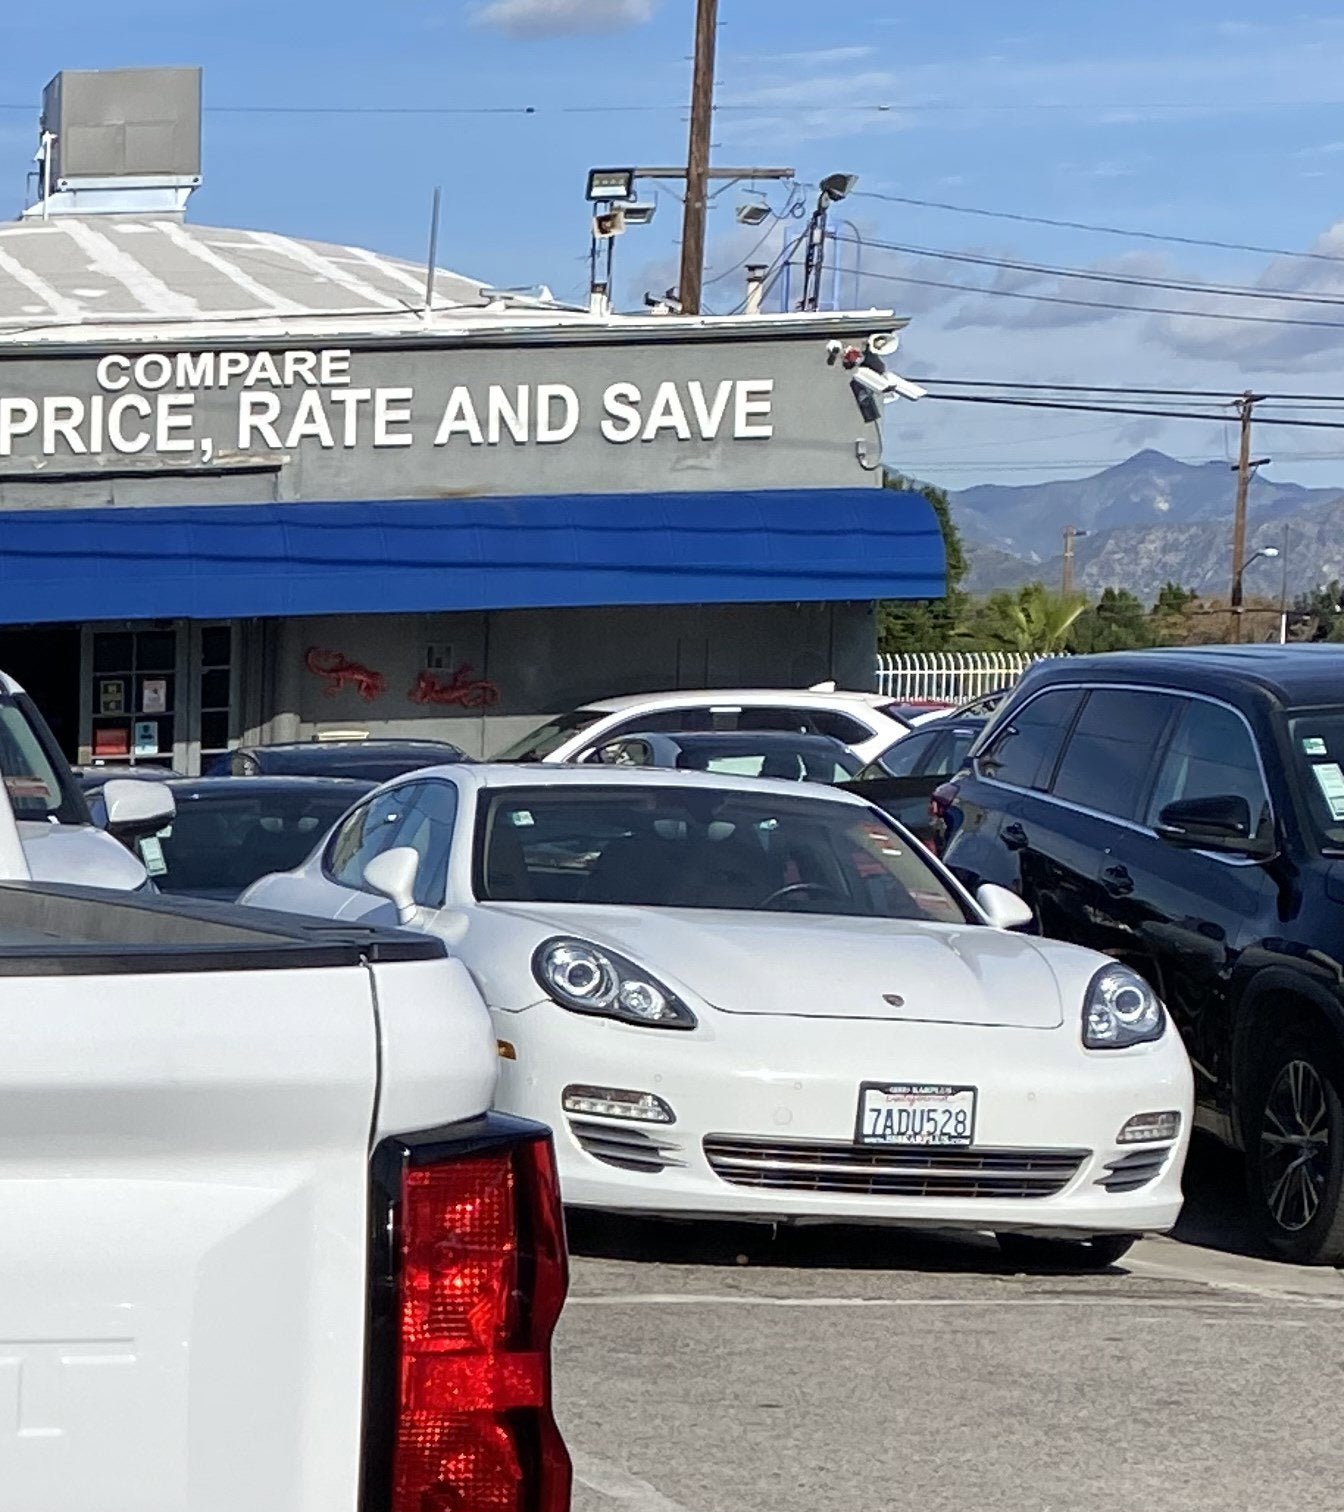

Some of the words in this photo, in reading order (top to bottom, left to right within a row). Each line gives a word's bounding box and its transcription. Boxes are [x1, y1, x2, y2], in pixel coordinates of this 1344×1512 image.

[97, 350, 351, 391] COMPARE
[0, 393, 213, 463] PRICE,
[237, 387, 413, 449] RATE
[433, 384, 580, 446] AND
[600, 379, 774, 442] SAVE
[869, 1108, 967, 1136] 7ADU528
